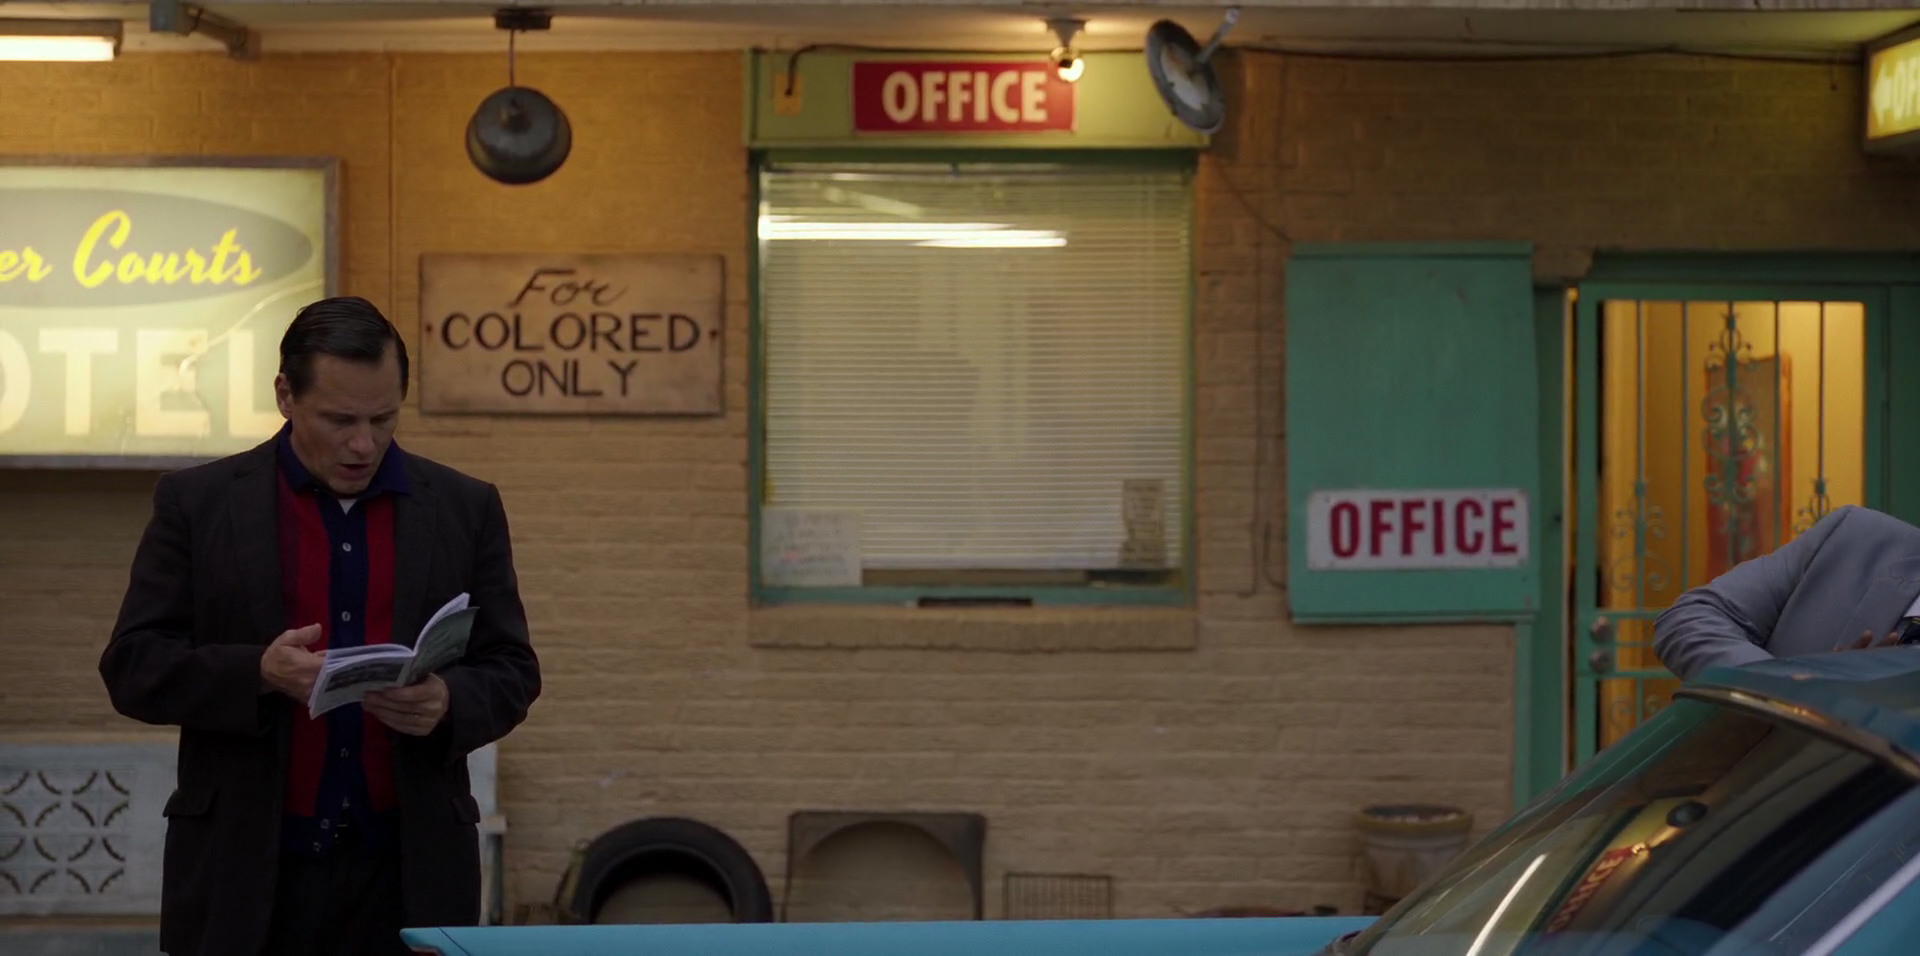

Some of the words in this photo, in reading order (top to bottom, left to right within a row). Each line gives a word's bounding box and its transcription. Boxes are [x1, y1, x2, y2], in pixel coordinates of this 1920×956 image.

[882, 71, 1048, 123] OFFICE
[73, 210, 262, 288] Courts
[508, 267, 628, 308] For
[441, 313, 700, 351] COLORED
[502, 359, 638, 397] ONLY
[1329, 497, 1518, 559] OFFICE
